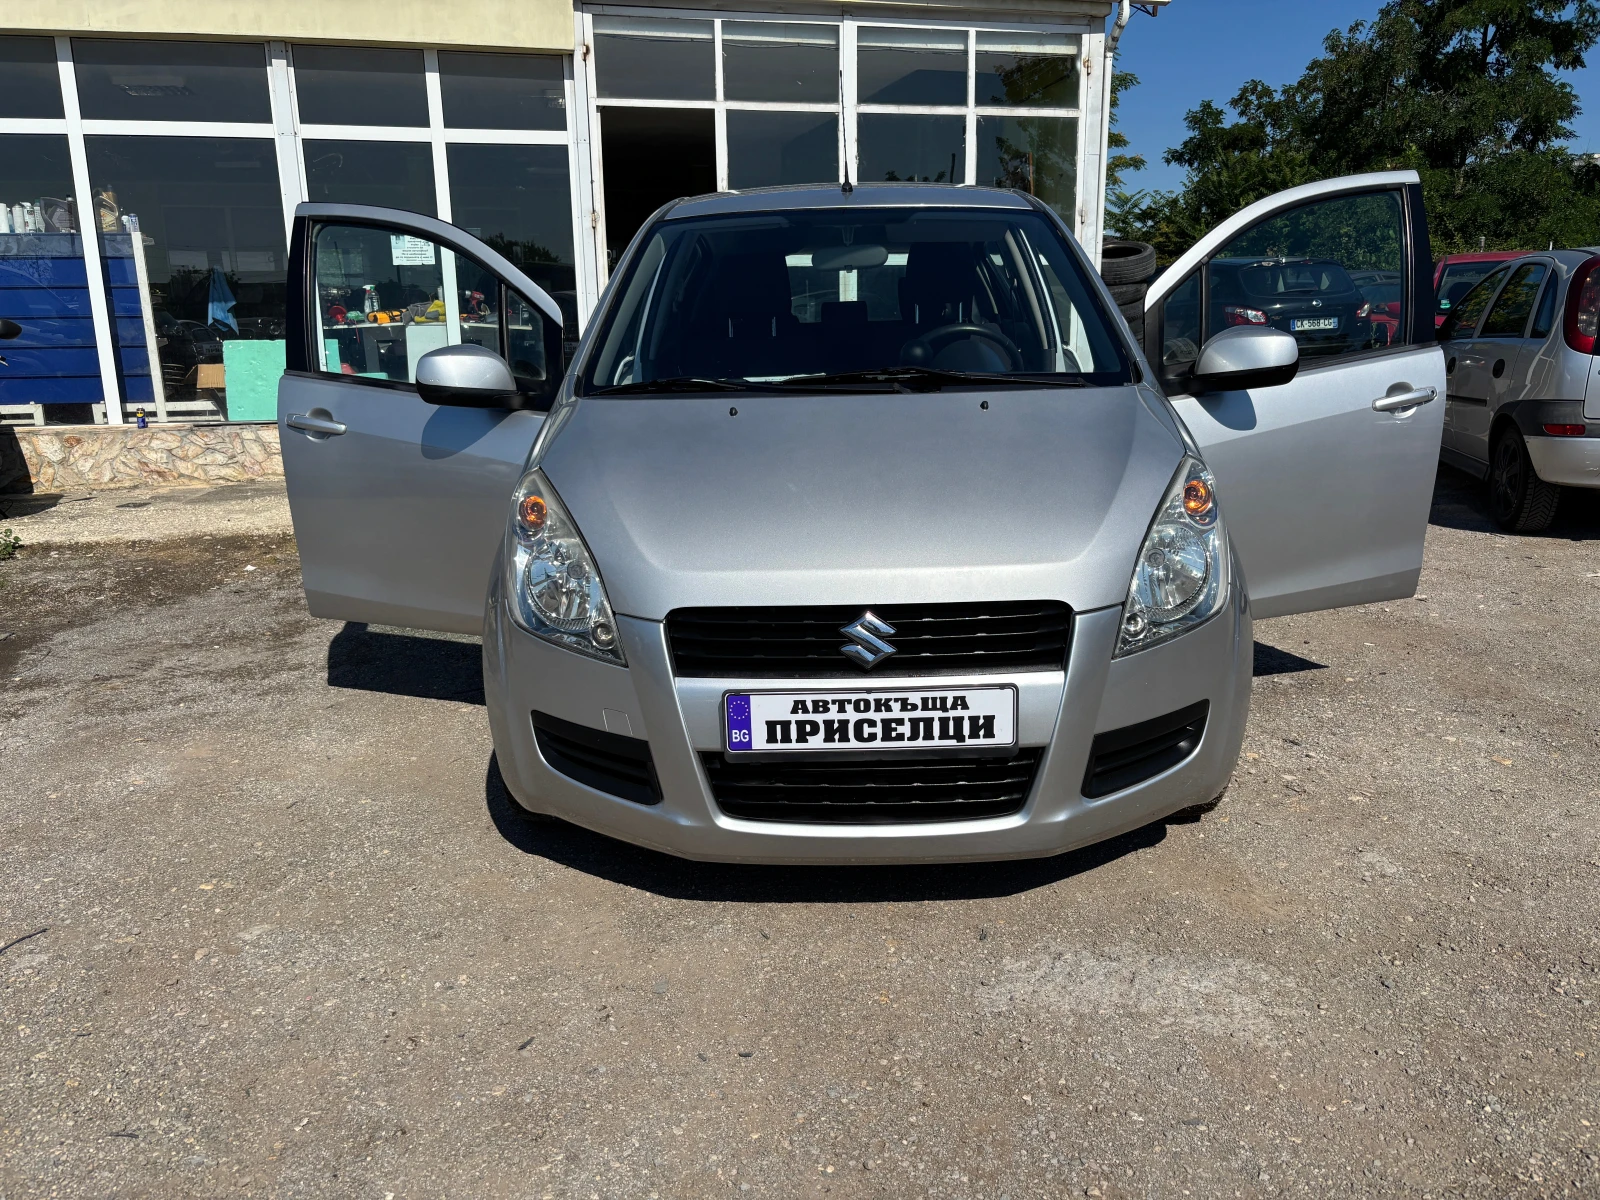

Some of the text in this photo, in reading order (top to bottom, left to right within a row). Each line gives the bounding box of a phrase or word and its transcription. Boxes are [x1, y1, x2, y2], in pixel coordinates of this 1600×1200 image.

[790, 695, 970, 714] АВТОКЪЩА
[732, 729, 749, 743] BG
[765, 715, 996, 744] ПРИСЕЛЦИ
